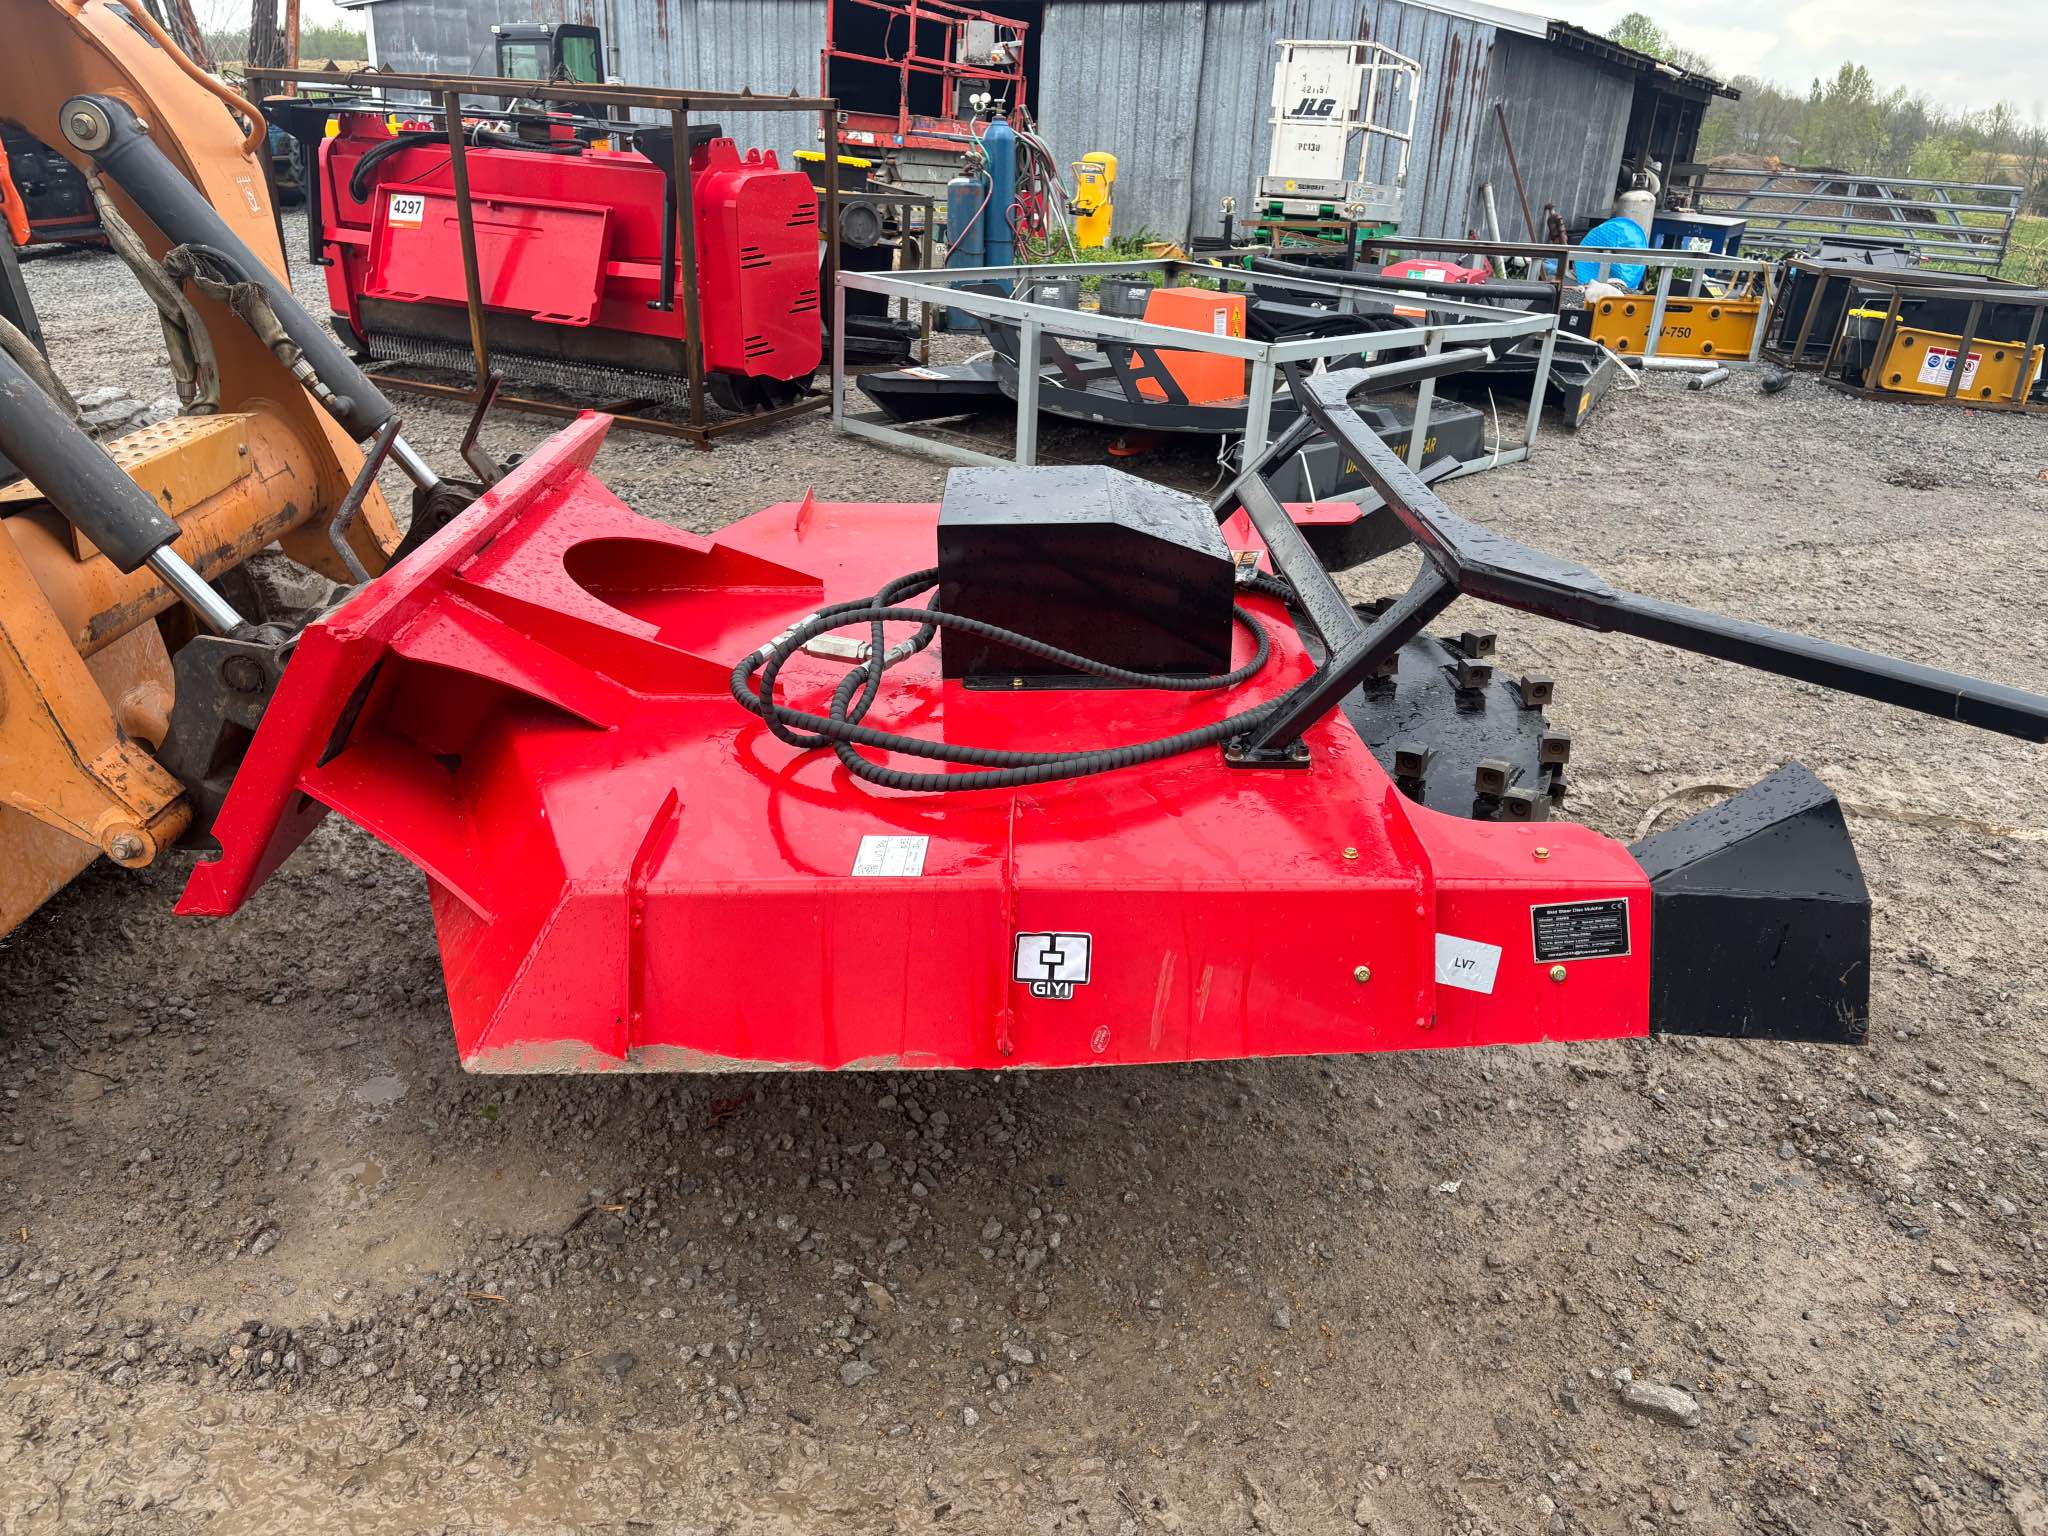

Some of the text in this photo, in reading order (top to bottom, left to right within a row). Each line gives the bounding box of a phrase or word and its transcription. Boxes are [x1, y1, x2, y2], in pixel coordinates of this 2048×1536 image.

[1291, 98, 1336, 116] JLG
[394, 200, 421, 214] 4297
[1454, 957, 1476, 970] LV7
[1033, 981, 1069, 996] GIYI
